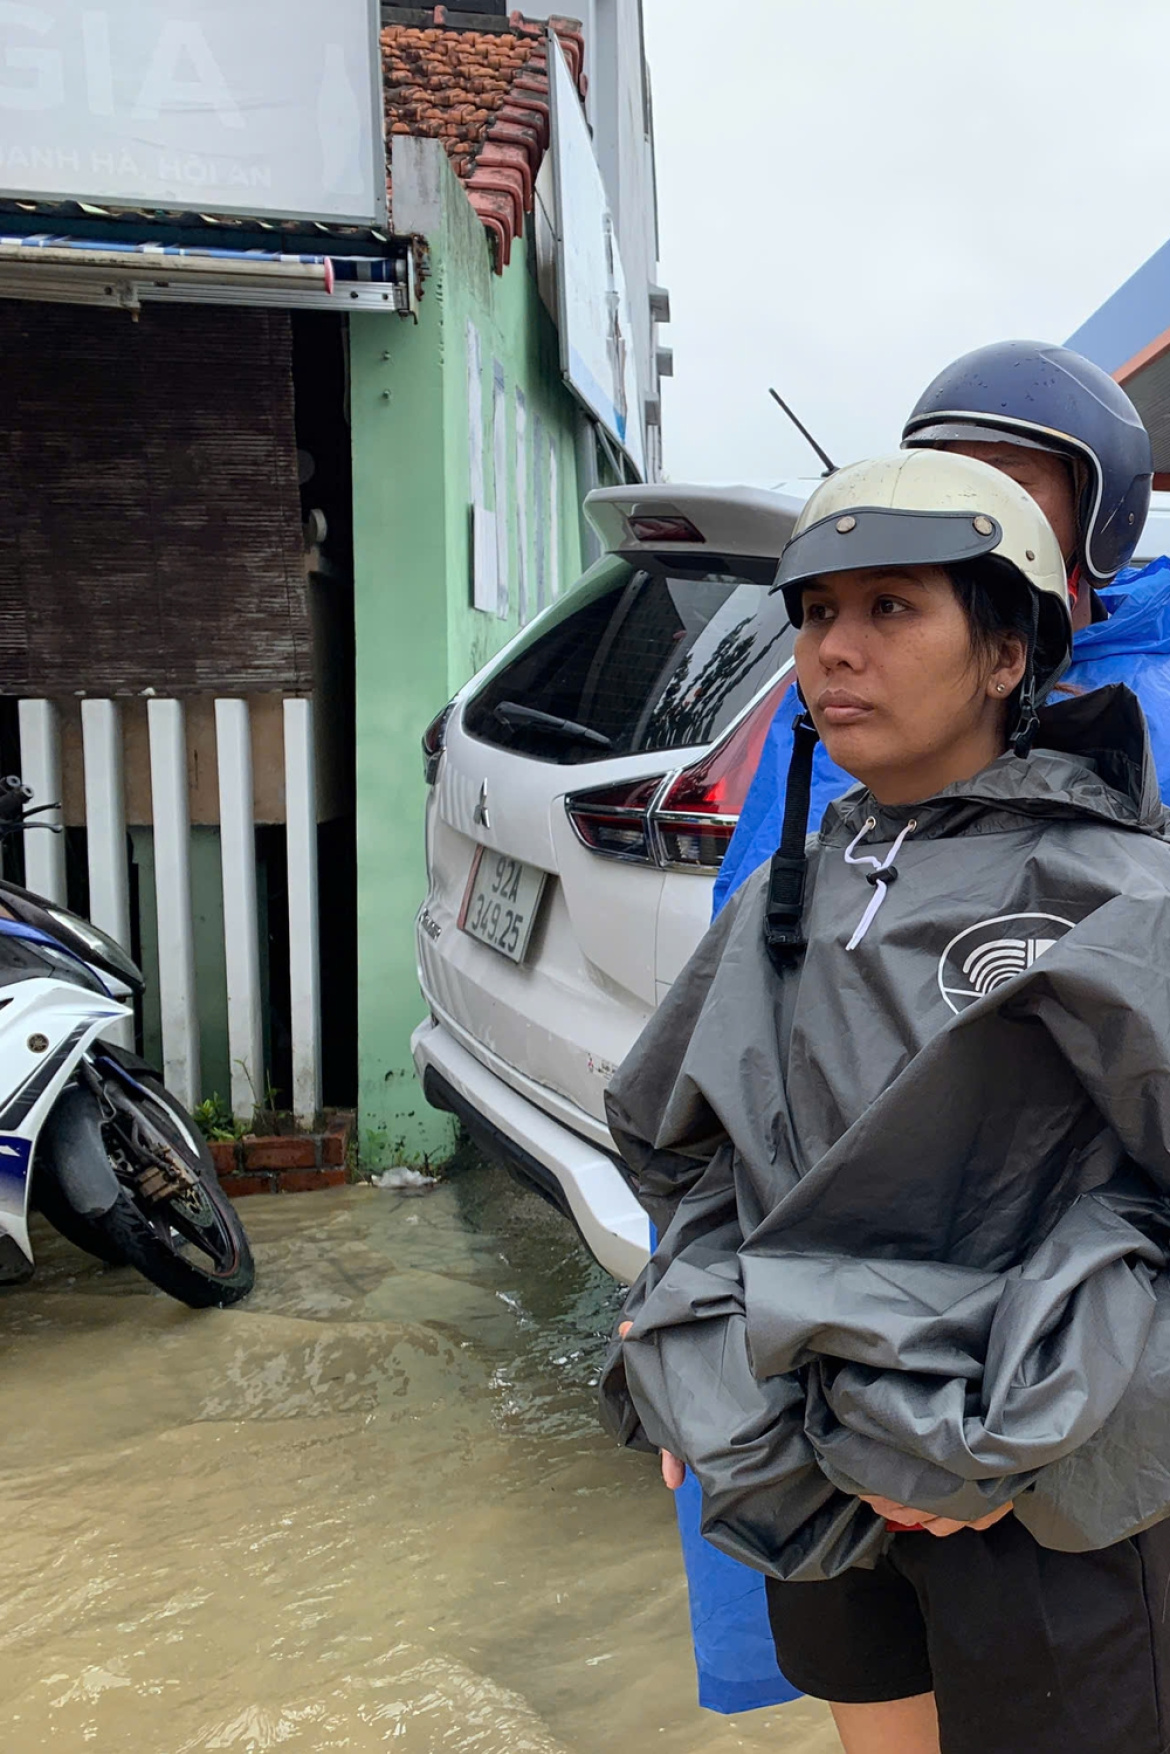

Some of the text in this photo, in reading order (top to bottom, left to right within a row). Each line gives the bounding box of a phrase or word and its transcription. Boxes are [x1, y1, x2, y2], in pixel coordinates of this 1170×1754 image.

[0, 145, 80, 172] ANH
[227, 165, 272, 188] AN
[492, 856, 523, 903] 92A
[471, 894, 524, 953] 349.25
